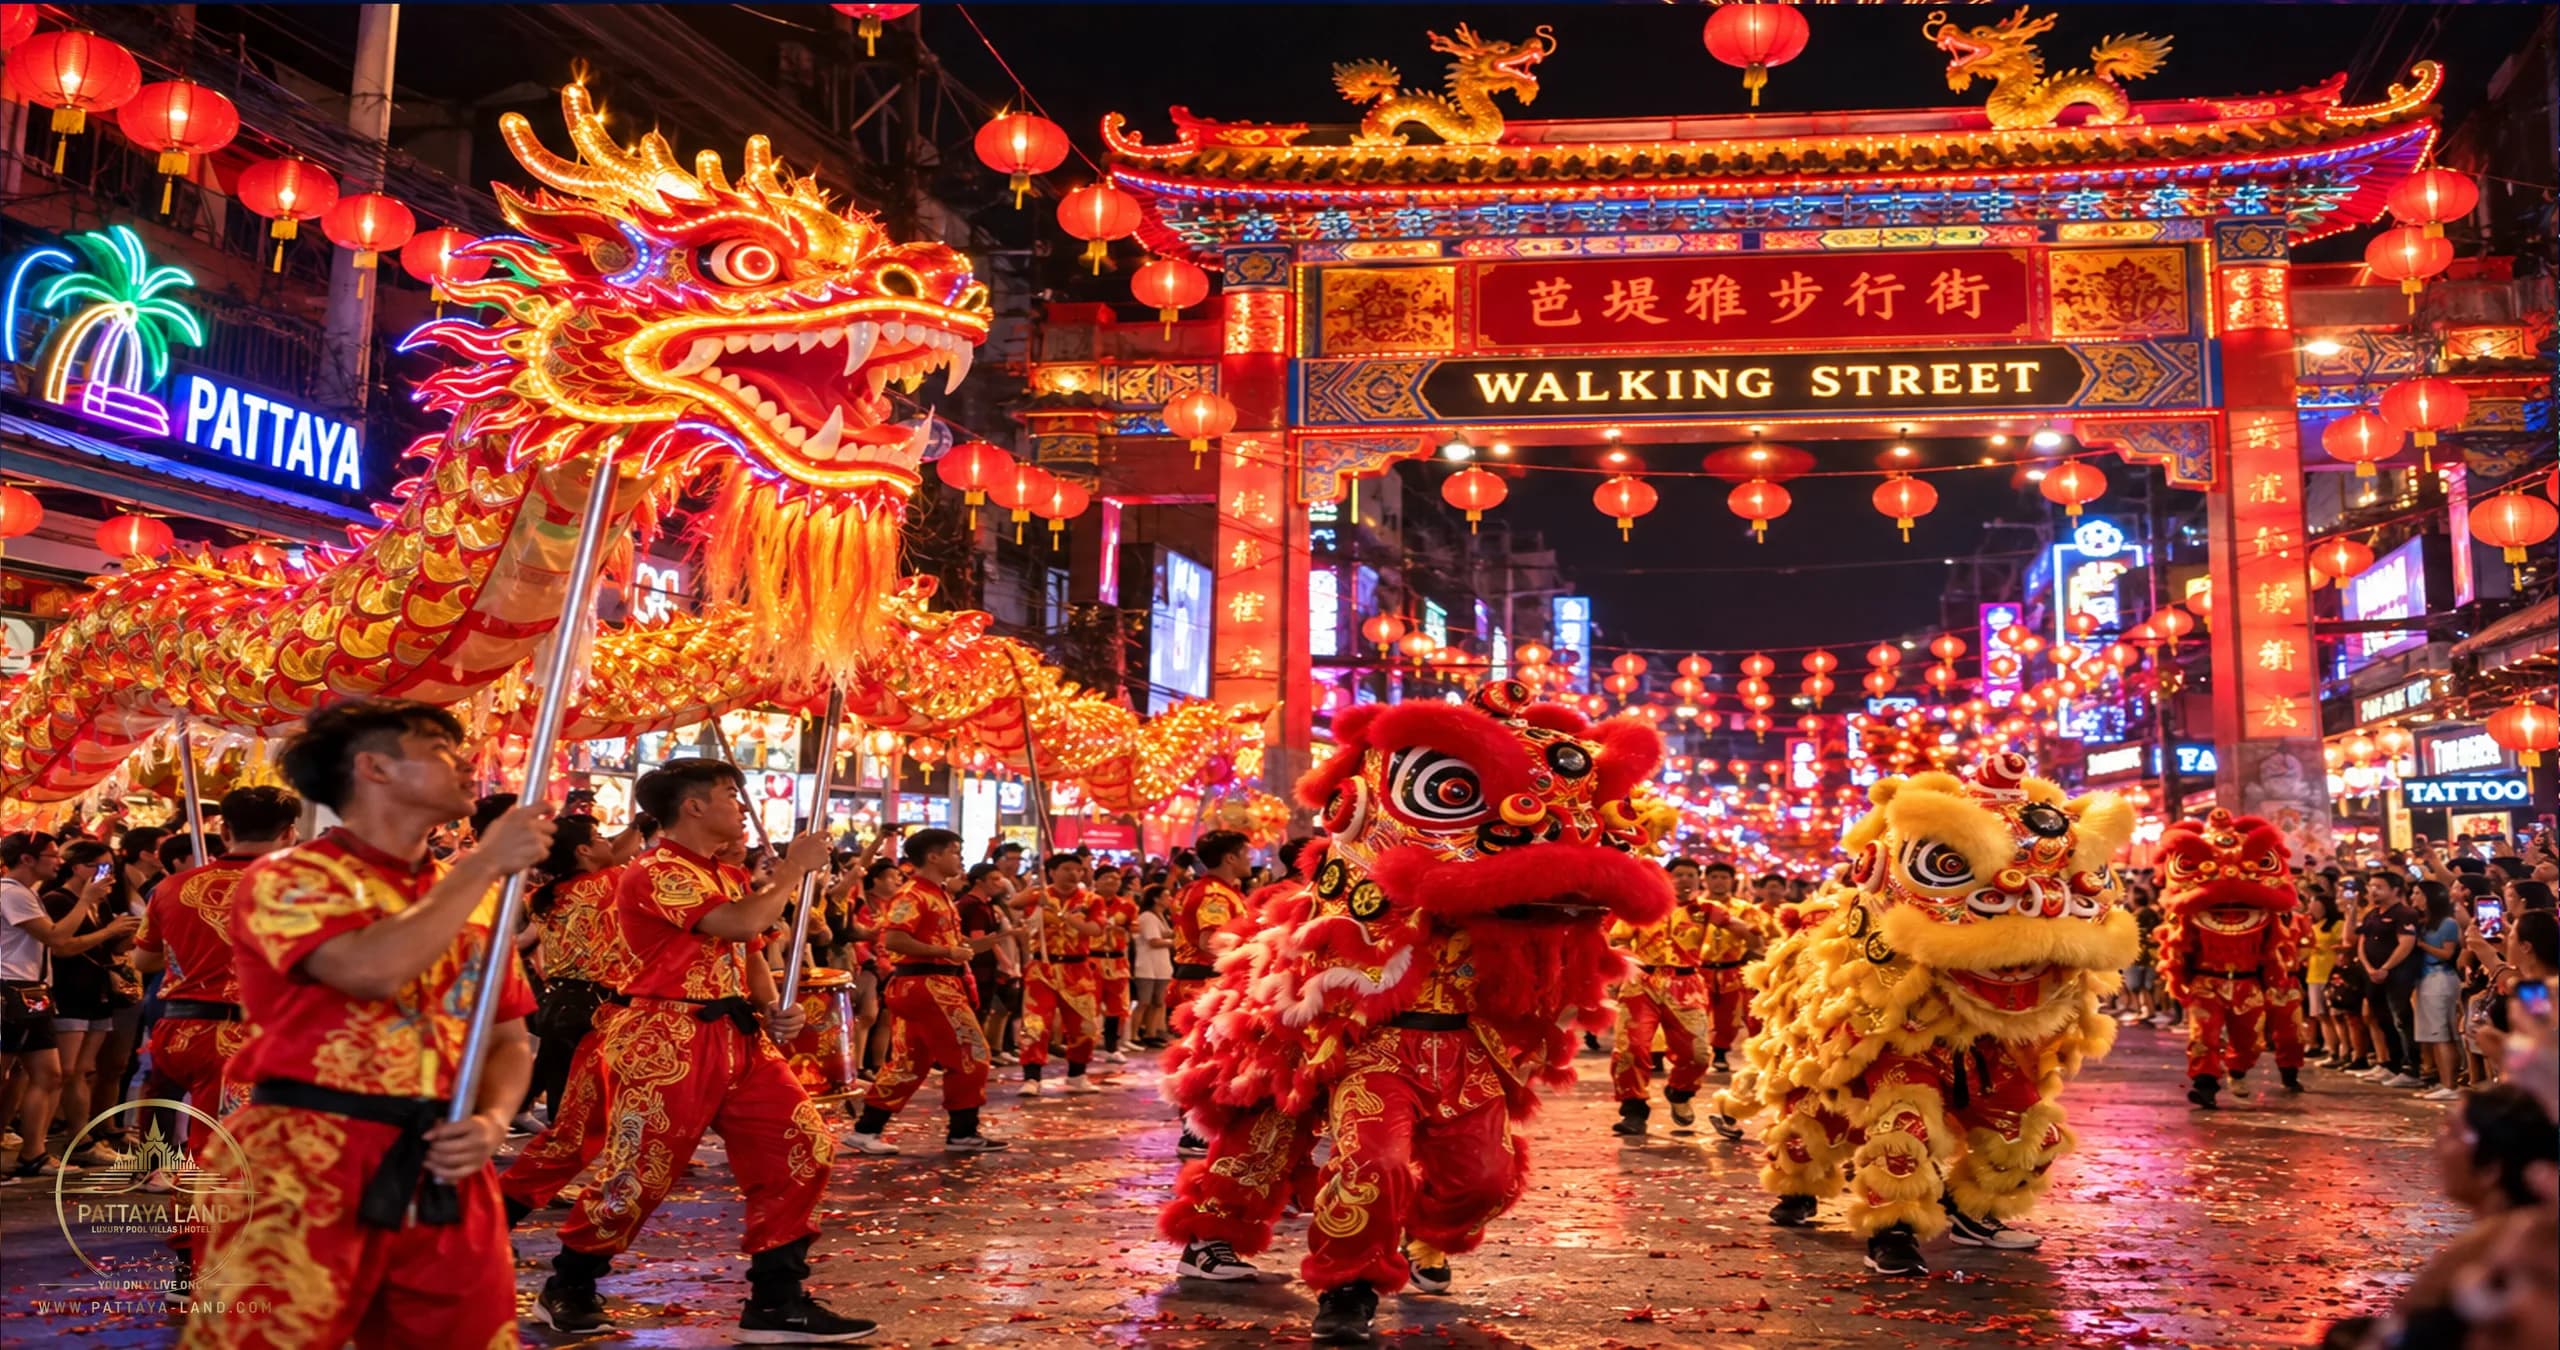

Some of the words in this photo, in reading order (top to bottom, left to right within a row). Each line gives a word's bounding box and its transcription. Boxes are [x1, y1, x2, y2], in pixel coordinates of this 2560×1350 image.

[1528, 267, 1991, 327] 芭堤雅步行街
[1473, 367, 1774, 403] WALKING
[1811, 361, 2041, 397] STREET
[185, 375, 361, 490] PATTAYA
[2405, 780, 2528, 803] TATTOO
